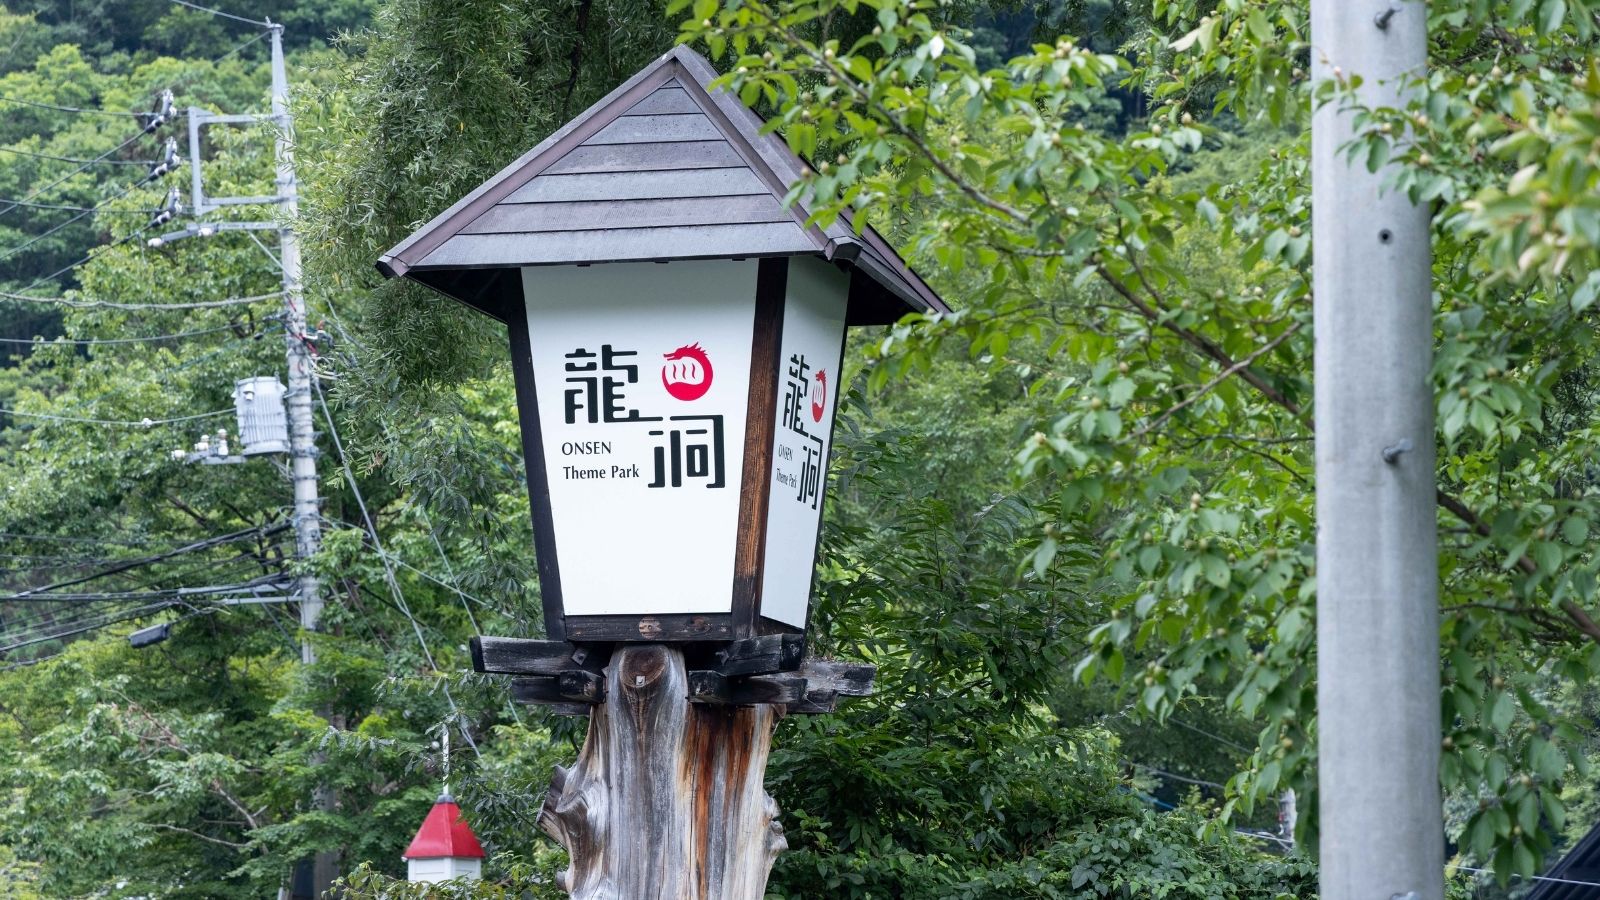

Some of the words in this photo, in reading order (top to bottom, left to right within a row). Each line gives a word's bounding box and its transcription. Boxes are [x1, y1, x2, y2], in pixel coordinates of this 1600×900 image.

[561, 441, 612, 455] ONSEN
[778, 444, 793, 462] ONSEN
[563, 465, 606, 480] Theme
[611, 464, 640, 479] Park
[776, 468, 788, 486] Theme
[788, 473, 797, 489] Park
